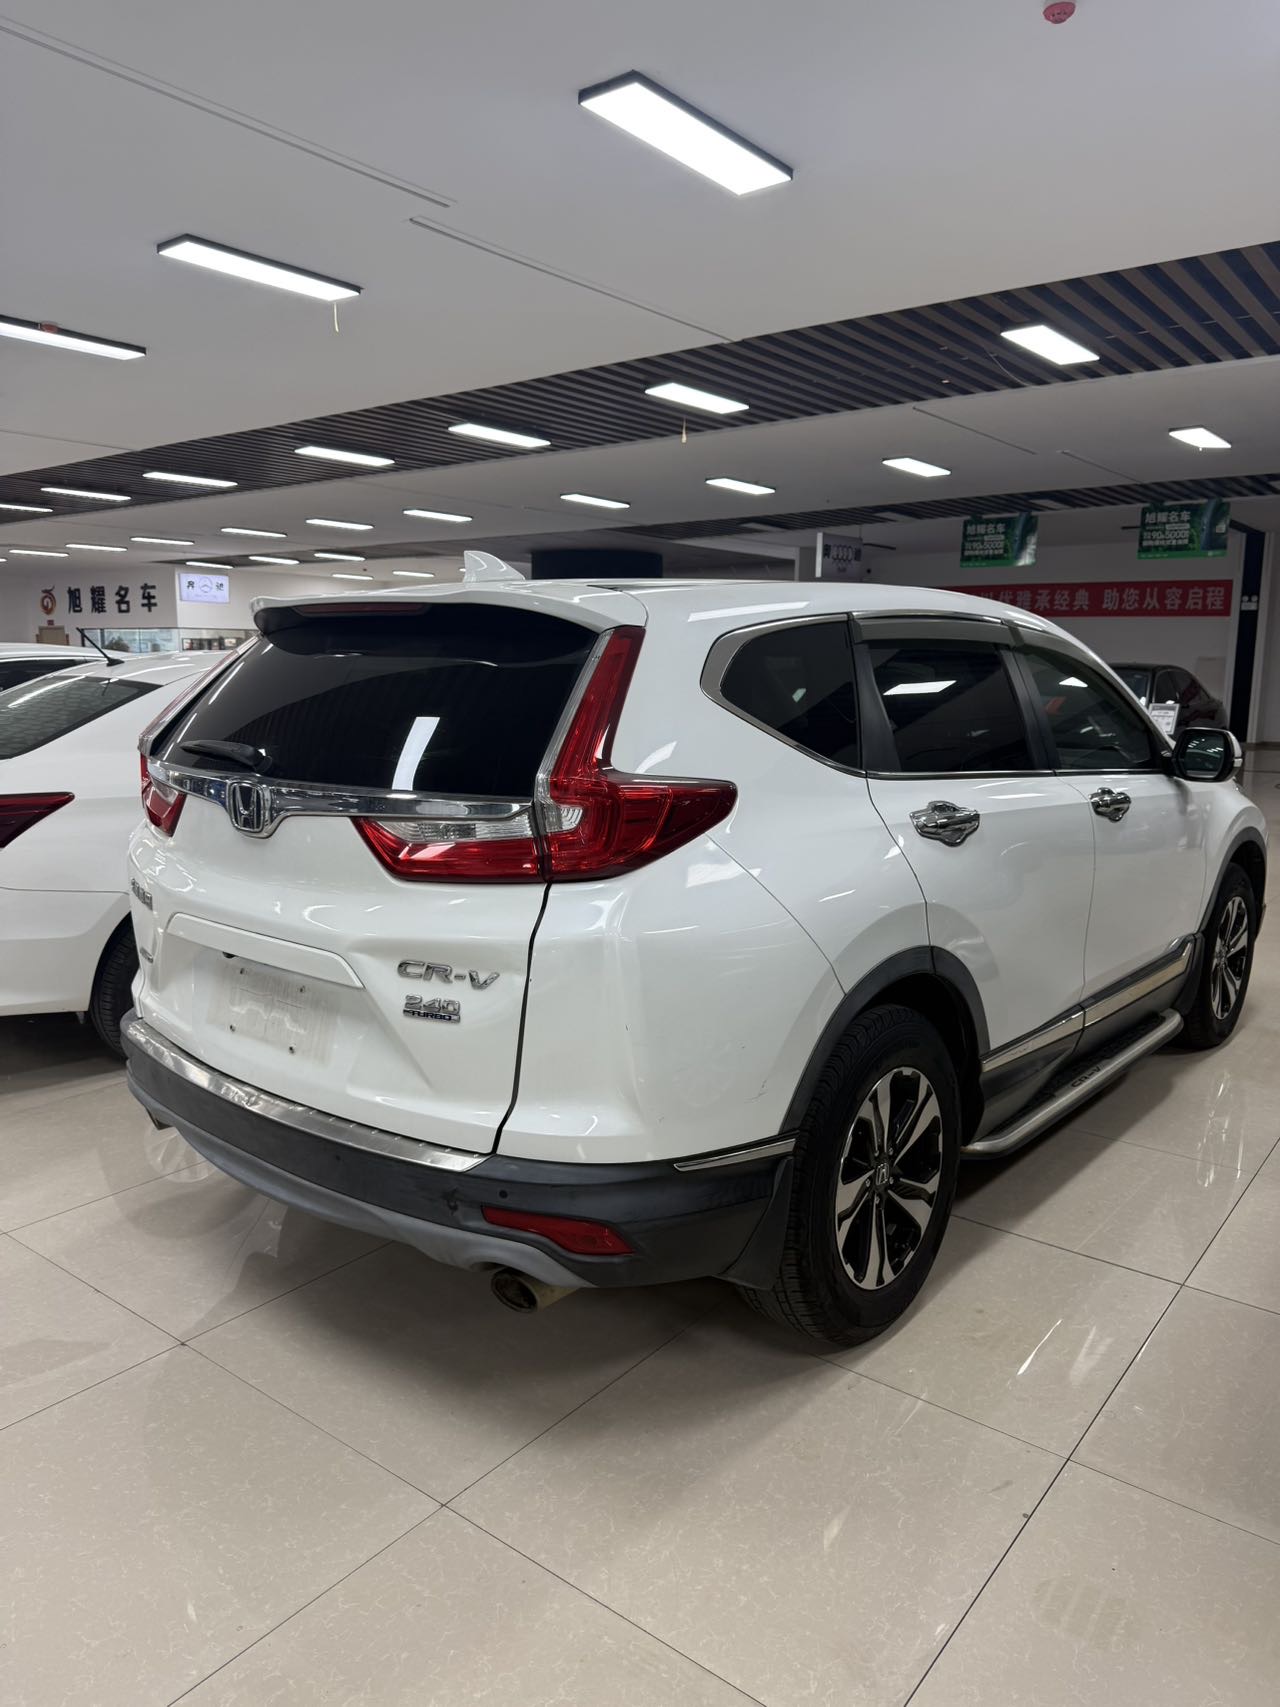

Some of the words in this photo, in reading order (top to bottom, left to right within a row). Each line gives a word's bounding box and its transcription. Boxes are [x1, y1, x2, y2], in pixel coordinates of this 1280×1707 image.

[67, 582, 158, 614] 旭耀名车
[1102, 586, 1226, 611] 助您从容启程
[397, 959, 500, 991] CR-V
[404, 994, 461, 1015] 240
[408, 1009, 453, 1022] TURBO
